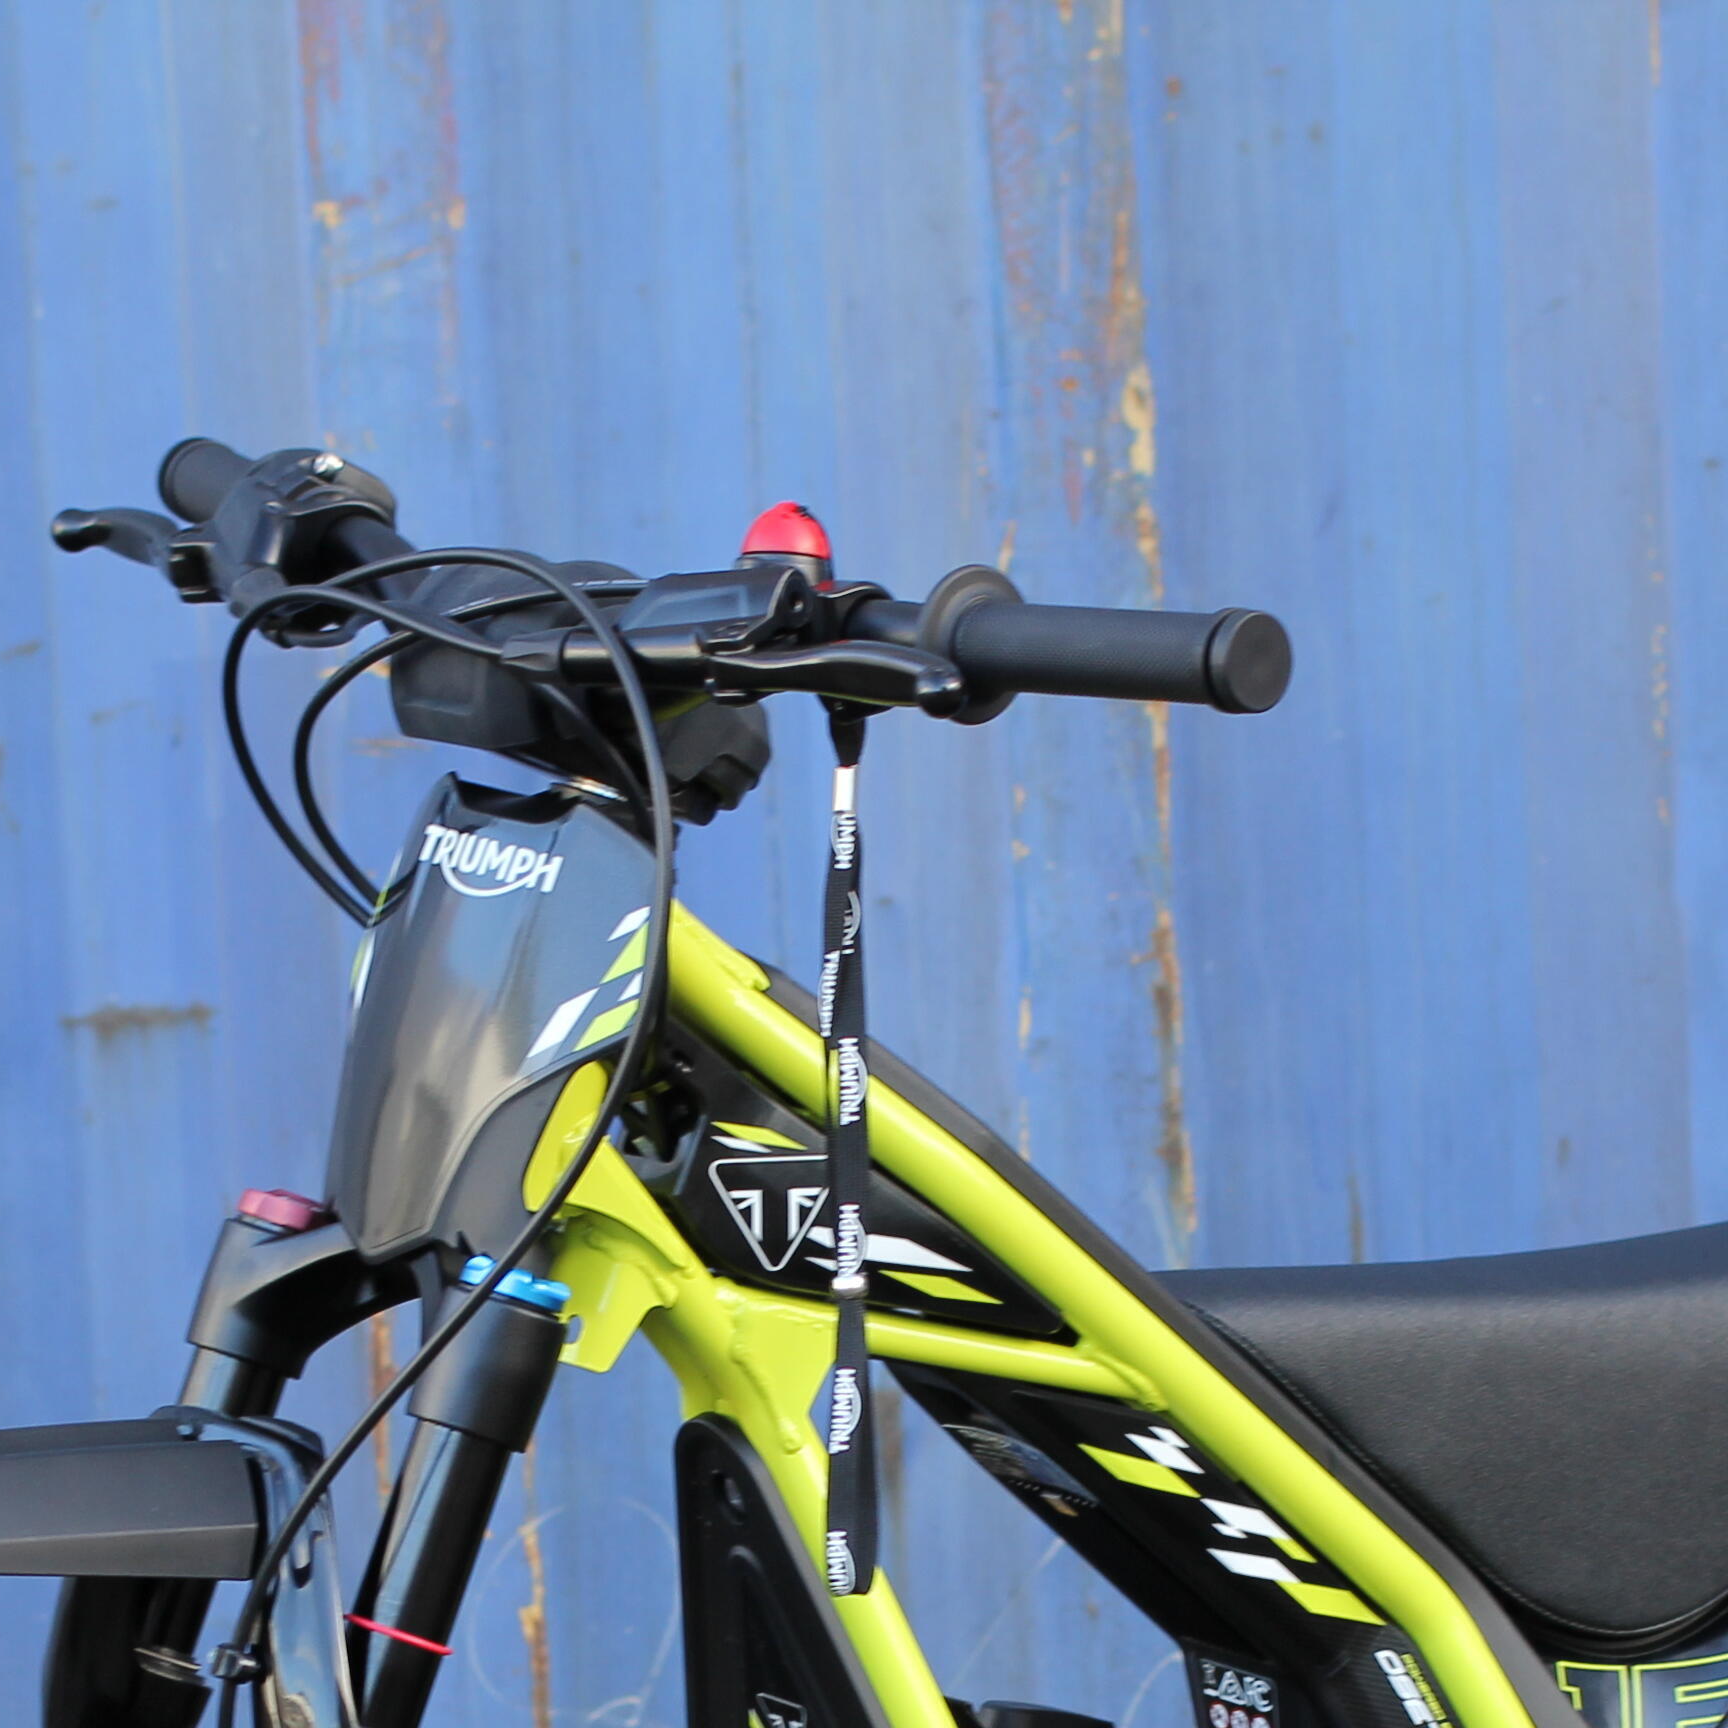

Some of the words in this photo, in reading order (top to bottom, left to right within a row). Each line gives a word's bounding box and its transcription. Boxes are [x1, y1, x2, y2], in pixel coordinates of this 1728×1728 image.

[418, 824, 564, 897] TRIUMPH
[831, 812, 857, 869] UMPH
[839, 1037, 868, 1126] TRIUMPH
[837, 1204, 866, 1277] RIUMPH
[829, 1368, 862, 1454] TRIUMPH
[826, 1531, 856, 1596] IUMPH
